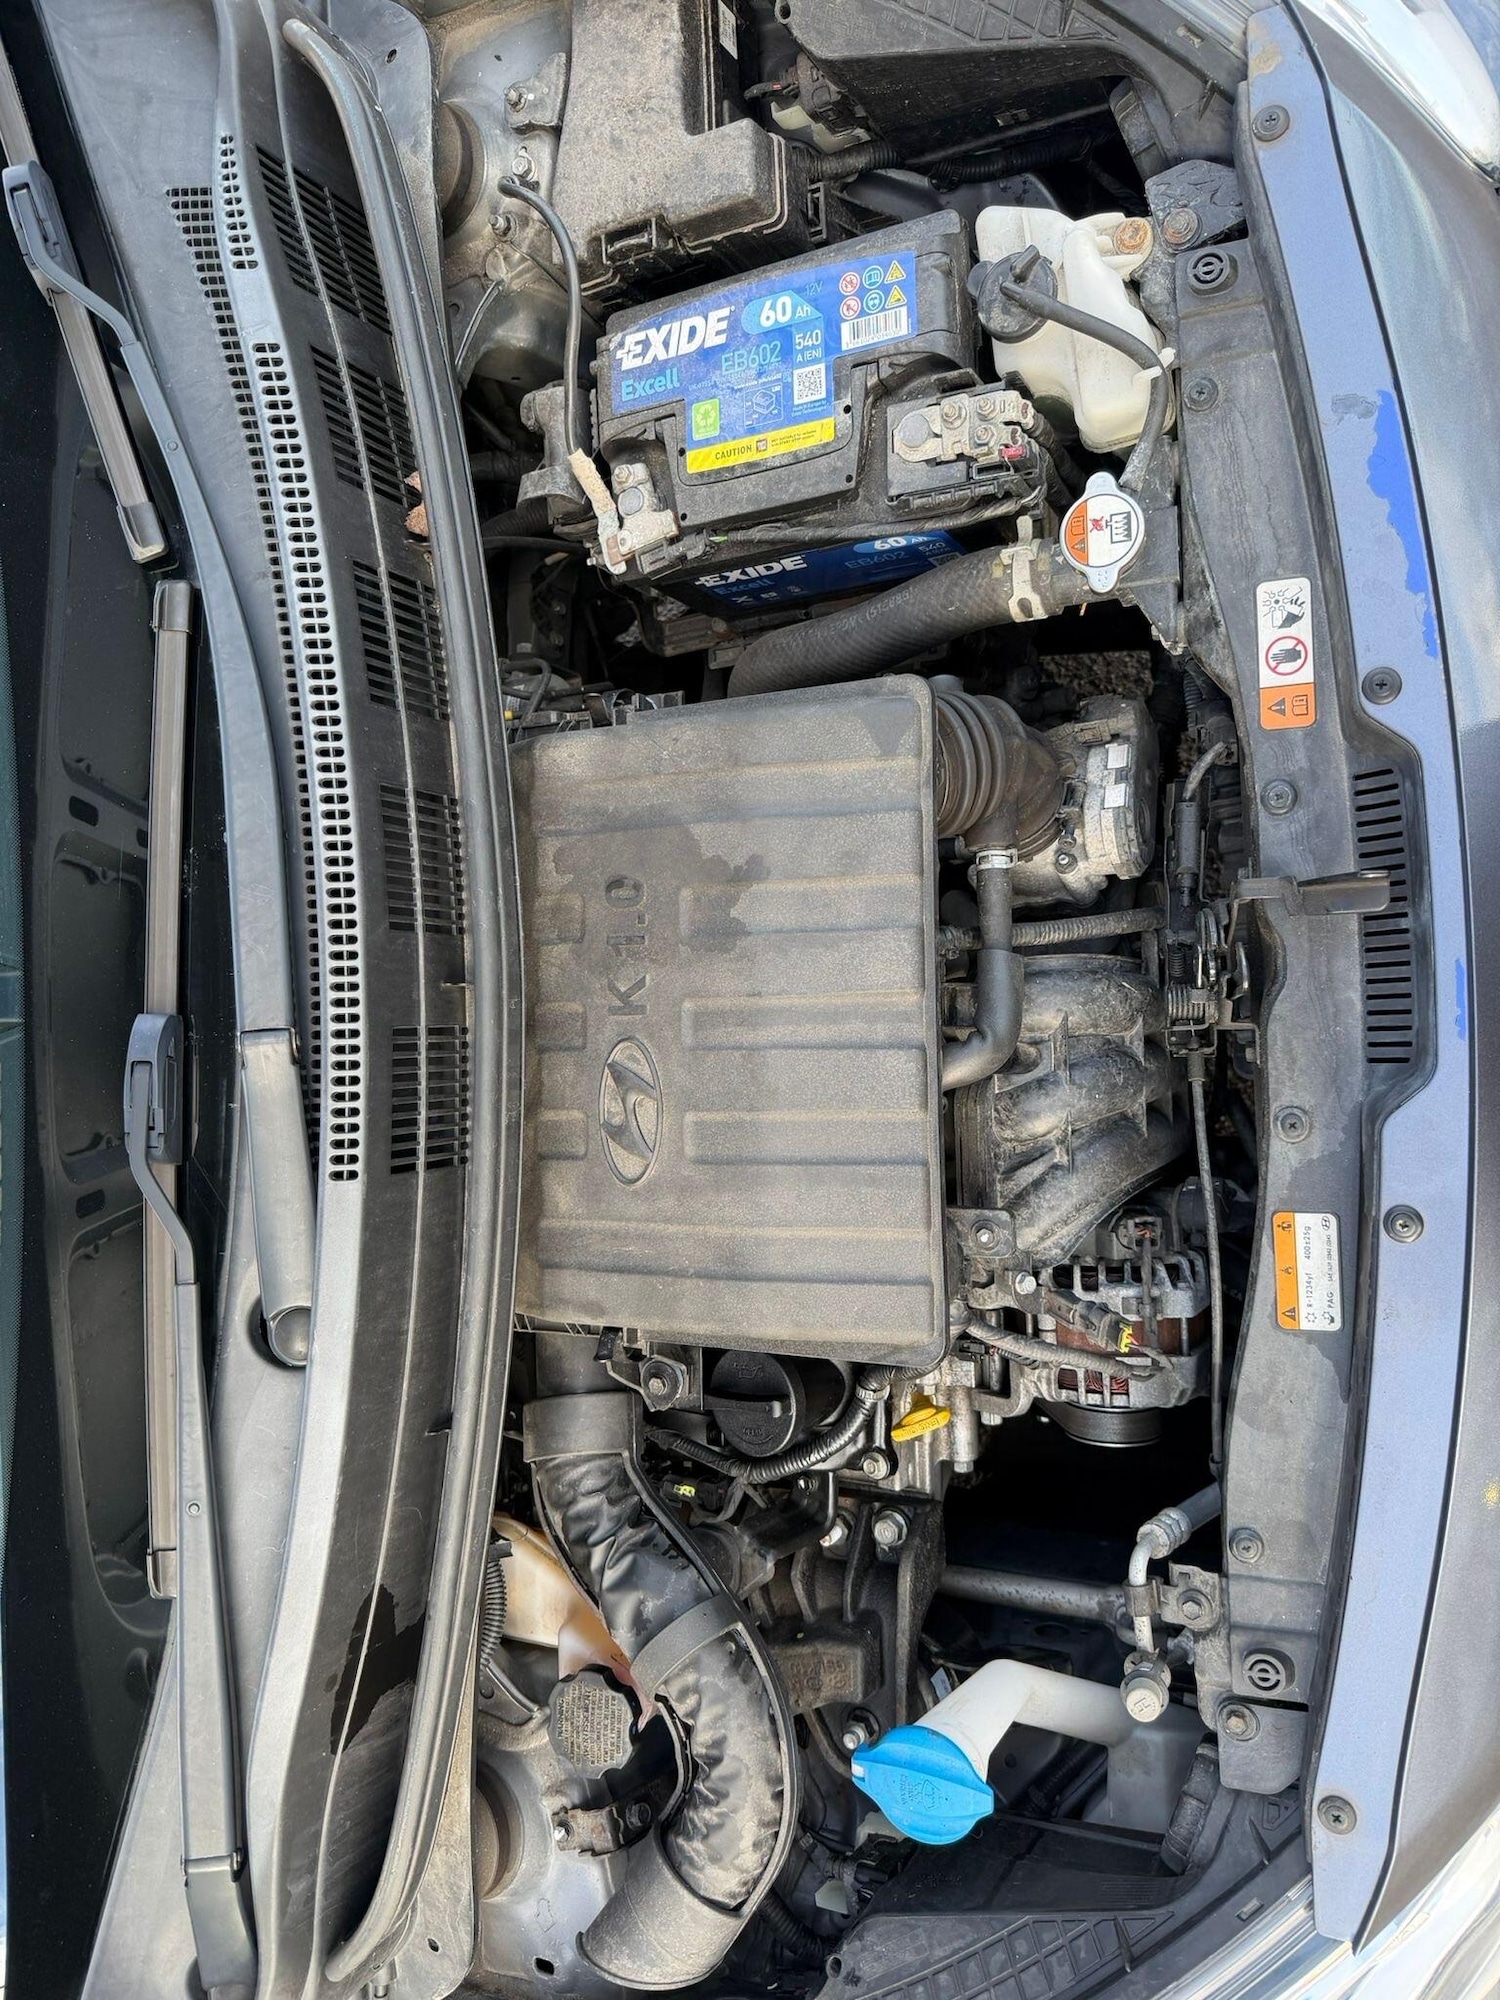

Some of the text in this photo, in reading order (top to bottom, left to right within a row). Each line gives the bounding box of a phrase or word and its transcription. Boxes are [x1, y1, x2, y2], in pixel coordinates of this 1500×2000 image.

[805, 282, 823, 296] 12V
[759, 295, 811, 328] 60 Ah
[616, 306, 731, 371] EXIDE
[795, 329, 822, 350] 540
[721, 341, 782, 375] EB602
[621, 368, 680, 402] Excell
[715, 444, 753, 461] CAUTION
[873, 536, 907, 551] 60
[844, 551, 910, 569] EB602
[694, 554, 808, 588] EXIDE
[712, 578, 775, 595] Excell
[1326, 1291, 1335, 1309] PAG
